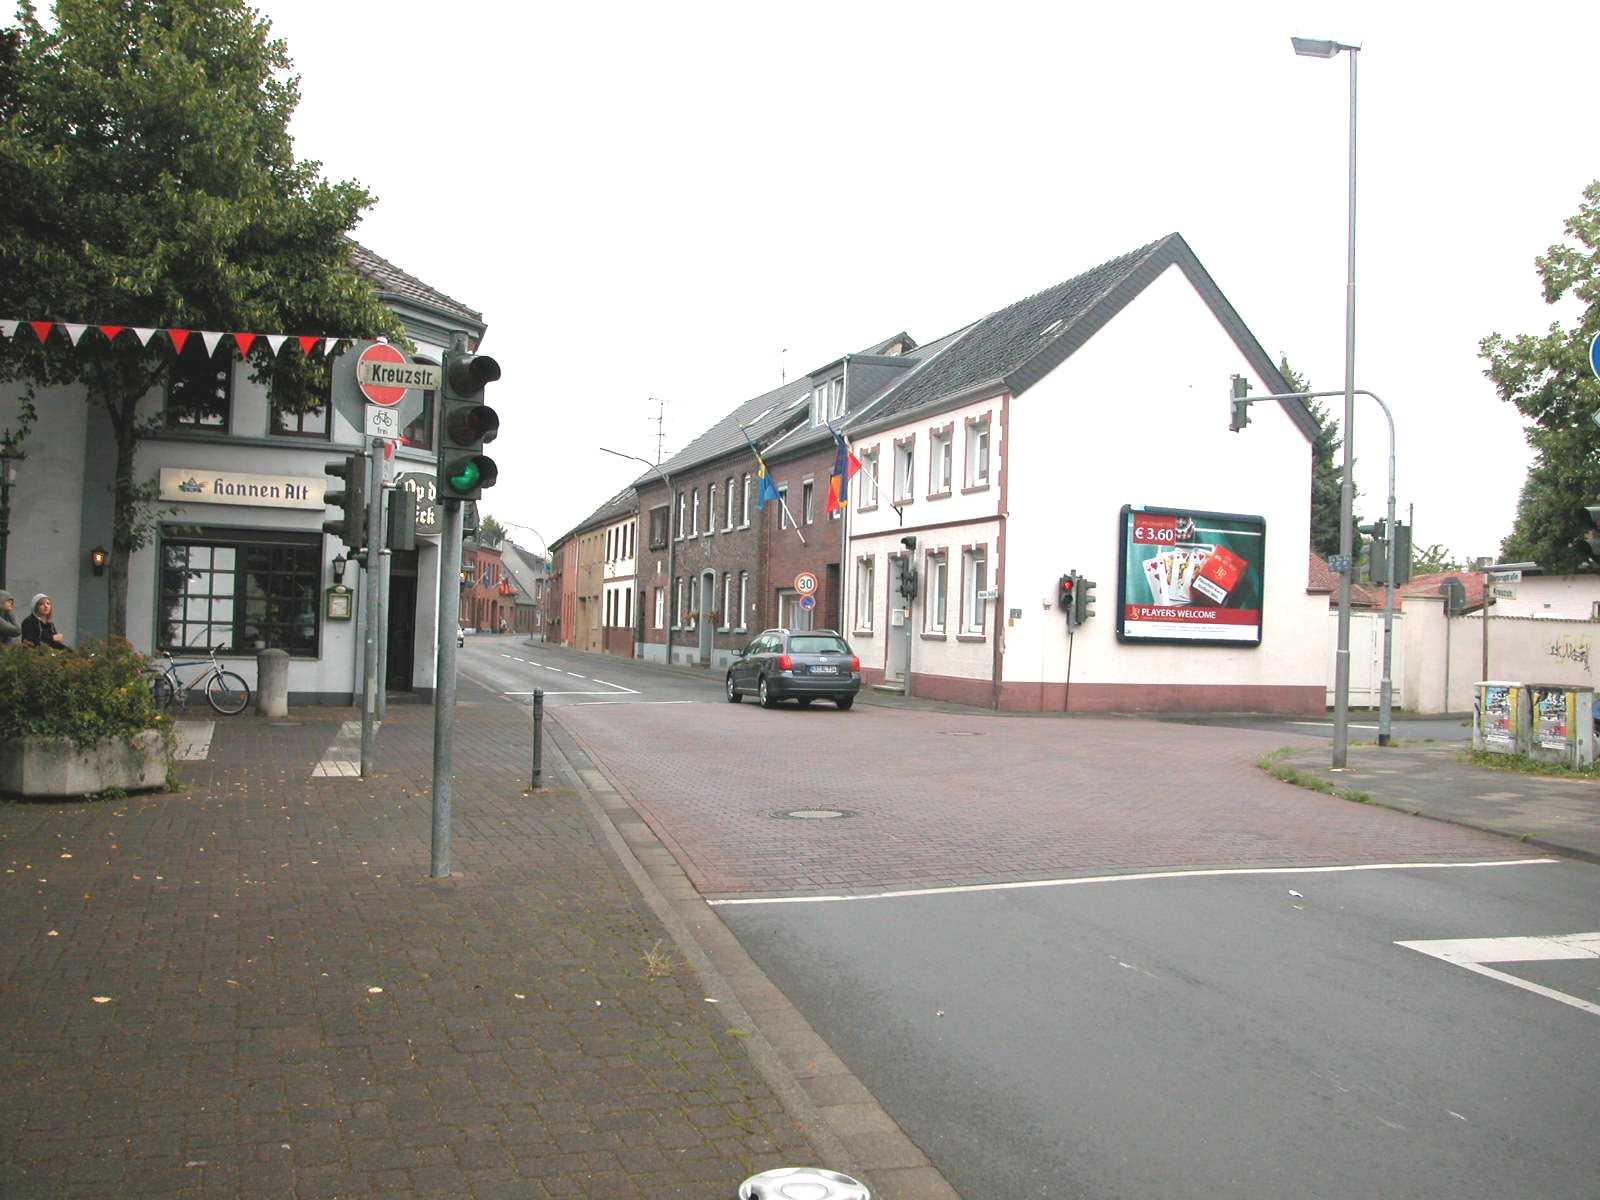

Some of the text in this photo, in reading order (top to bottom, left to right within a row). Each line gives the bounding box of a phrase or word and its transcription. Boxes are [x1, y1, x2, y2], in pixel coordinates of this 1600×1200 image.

[372, 364, 433, 386] Kreuzstr.
[285, 483, 309, 500] Alt
[1147, 528, 1174, 541] 3.60
[800, 579, 812, 589] 30
[1141, 608, 1217, 619] PLAYERS WELCOME
